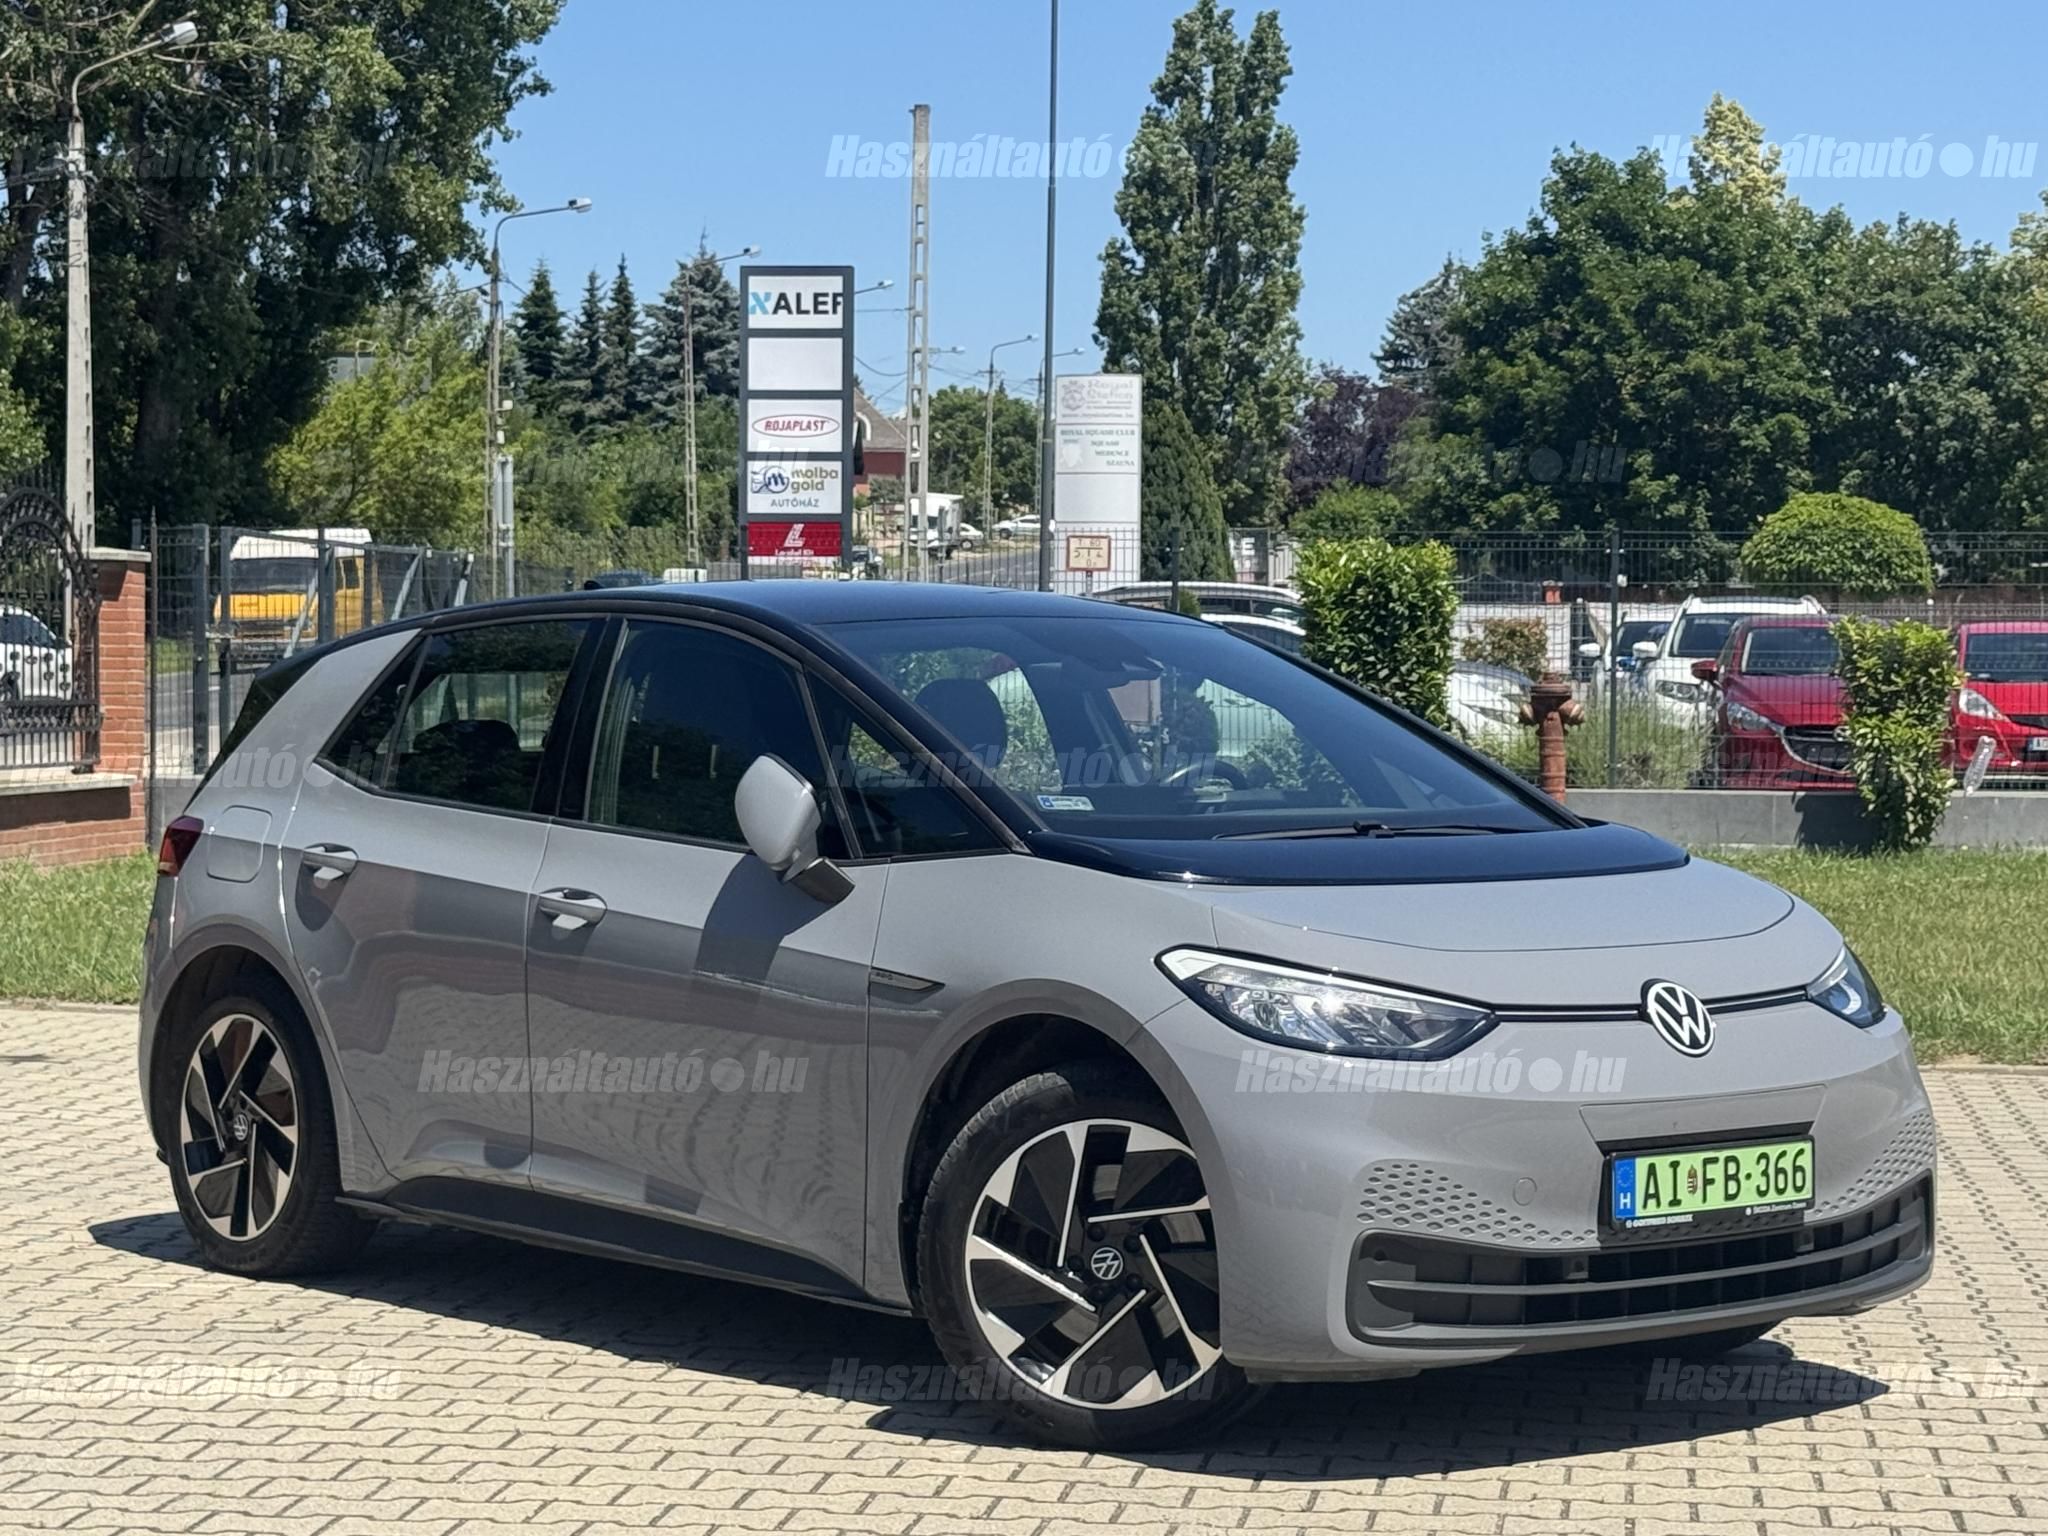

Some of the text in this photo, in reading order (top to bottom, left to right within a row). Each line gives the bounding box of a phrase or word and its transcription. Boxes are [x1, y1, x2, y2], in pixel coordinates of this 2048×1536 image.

[764, 420, 826, 432] ROJAPLAST
[791, 467, 839, 479] molba
[791, 480, 825, 494] gold
[770, 496, 820, 508] AUTÓHÁZ
[1619, 1192, 1631, 1211] H
